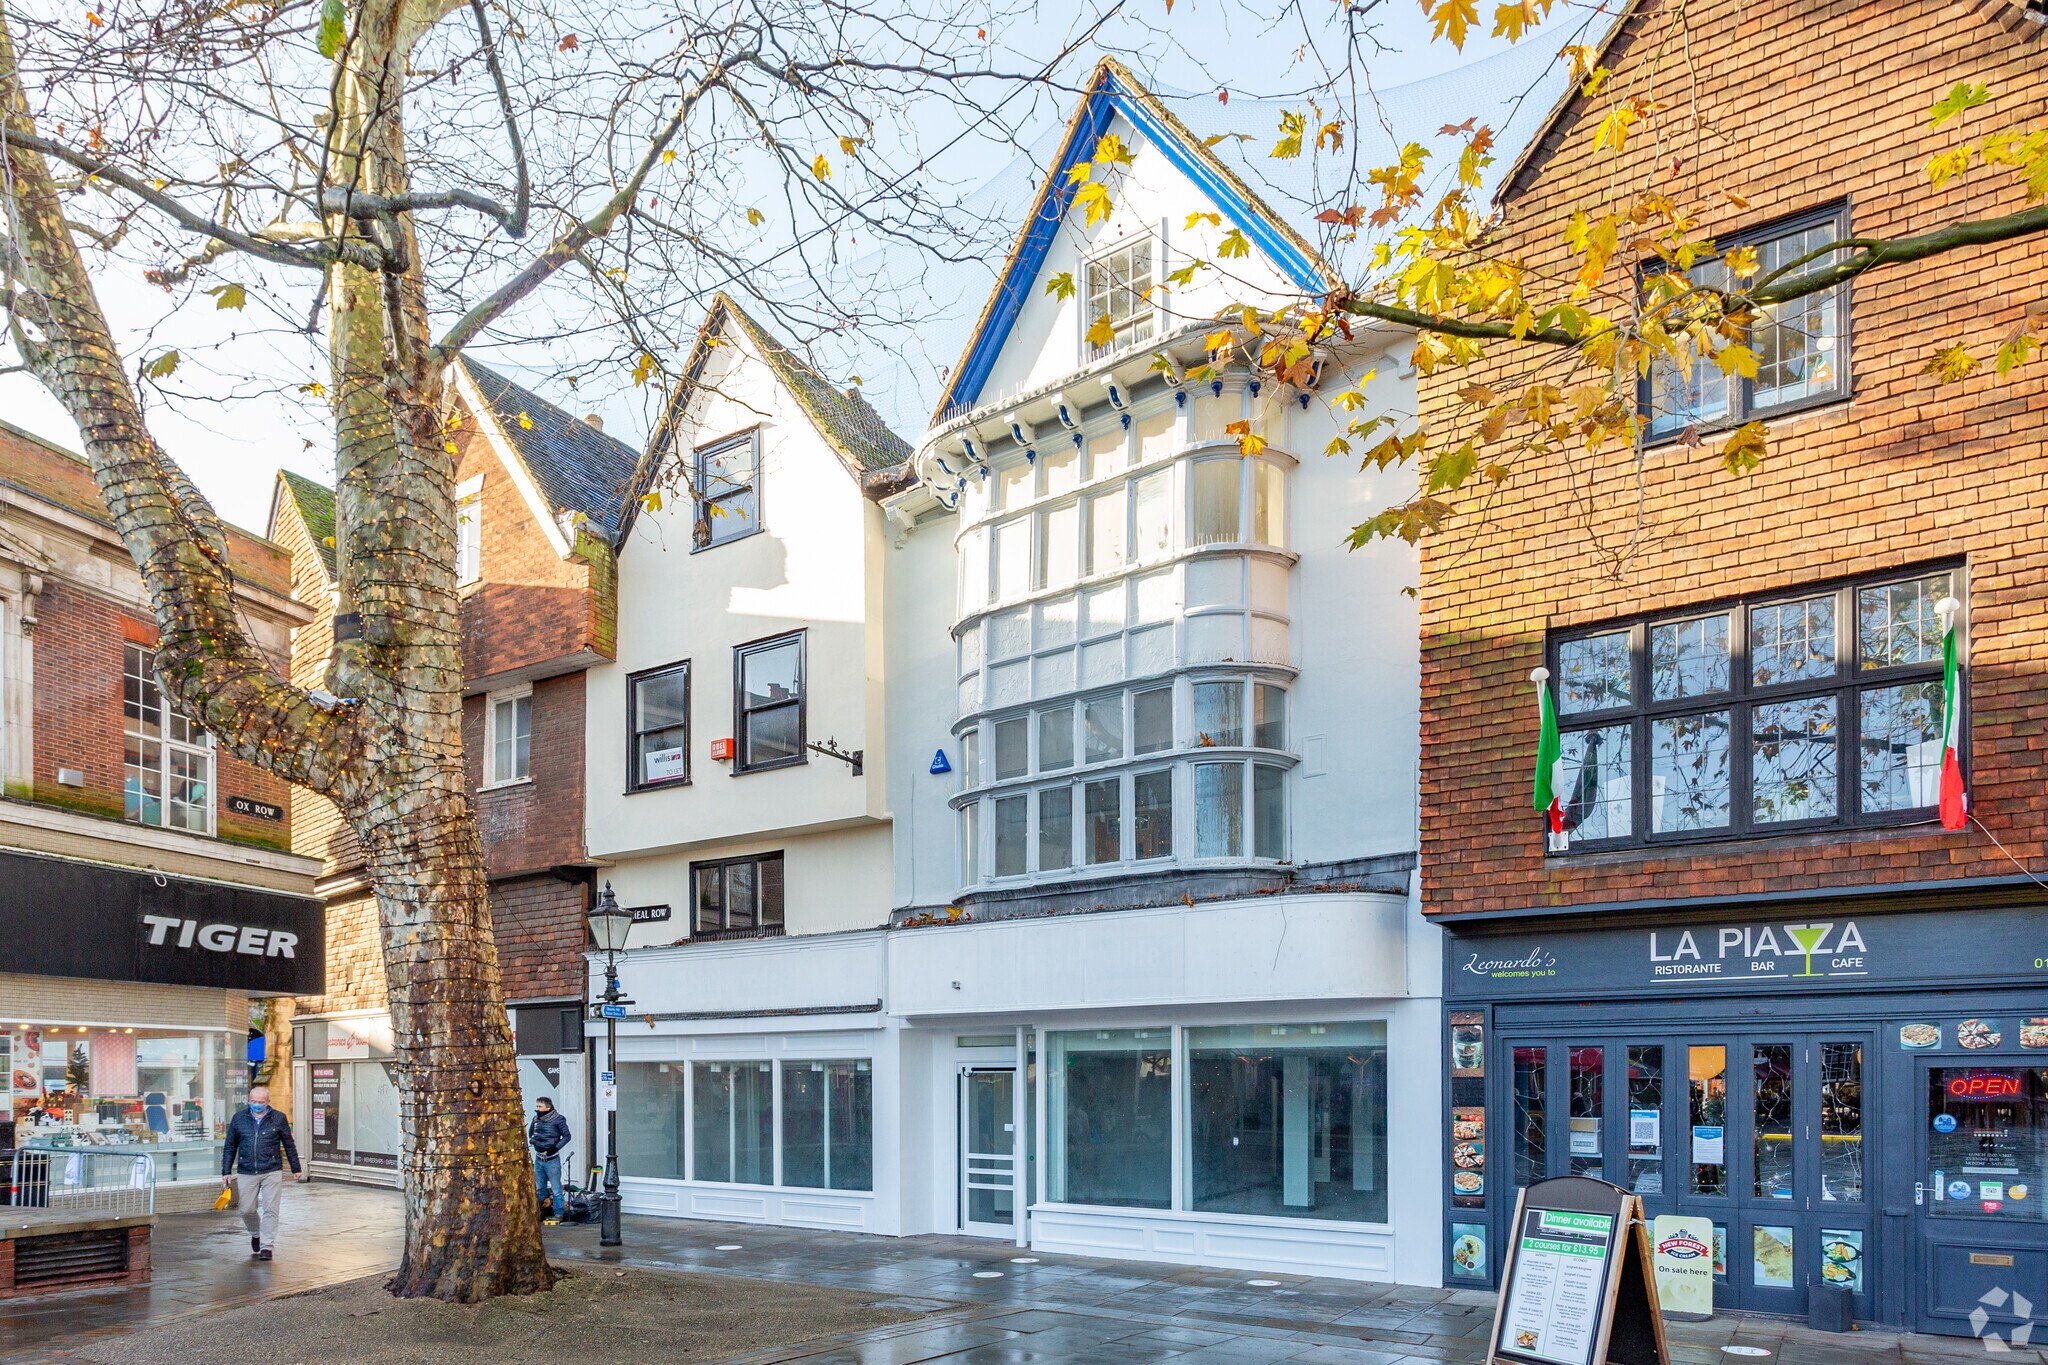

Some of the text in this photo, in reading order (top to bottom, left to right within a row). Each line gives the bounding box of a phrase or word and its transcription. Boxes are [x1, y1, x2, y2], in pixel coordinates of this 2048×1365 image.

[654, 754, 671, 764] willis
[236, 800, 275, 816] OX ROW
[651, 908, 667, 918] ROW
[143, 915, 298, 958] TIGER
[1650, 922, 1867, 961] LA PIAZZA
[1462, 946, 1556, 975] Leonardo's
[1655, 957, 1864, 975] RISTORANTE BAR CAFE
[1491, 970, 1530, 978] welcomes
[1531, 970, 1546, 978] you
[1950, 1079, 2020, 1095] OPEN
[313, 1091, 331, 1105] maplin
[1546, 1213, 1612, 1229] Dinner available
[1534, 1241, 1561, 1250] courses
[1562, 1243, 1572, 1252] for
[1573, 1244, 1599, 1255] £13.95
[1662, 1240, 1678, 1249] NEW
[1679, 1240, 1706, 1251] FOREST
[1658, 1265, 1670, 1273] On
[1690, 1268, 1708, 1276] here
